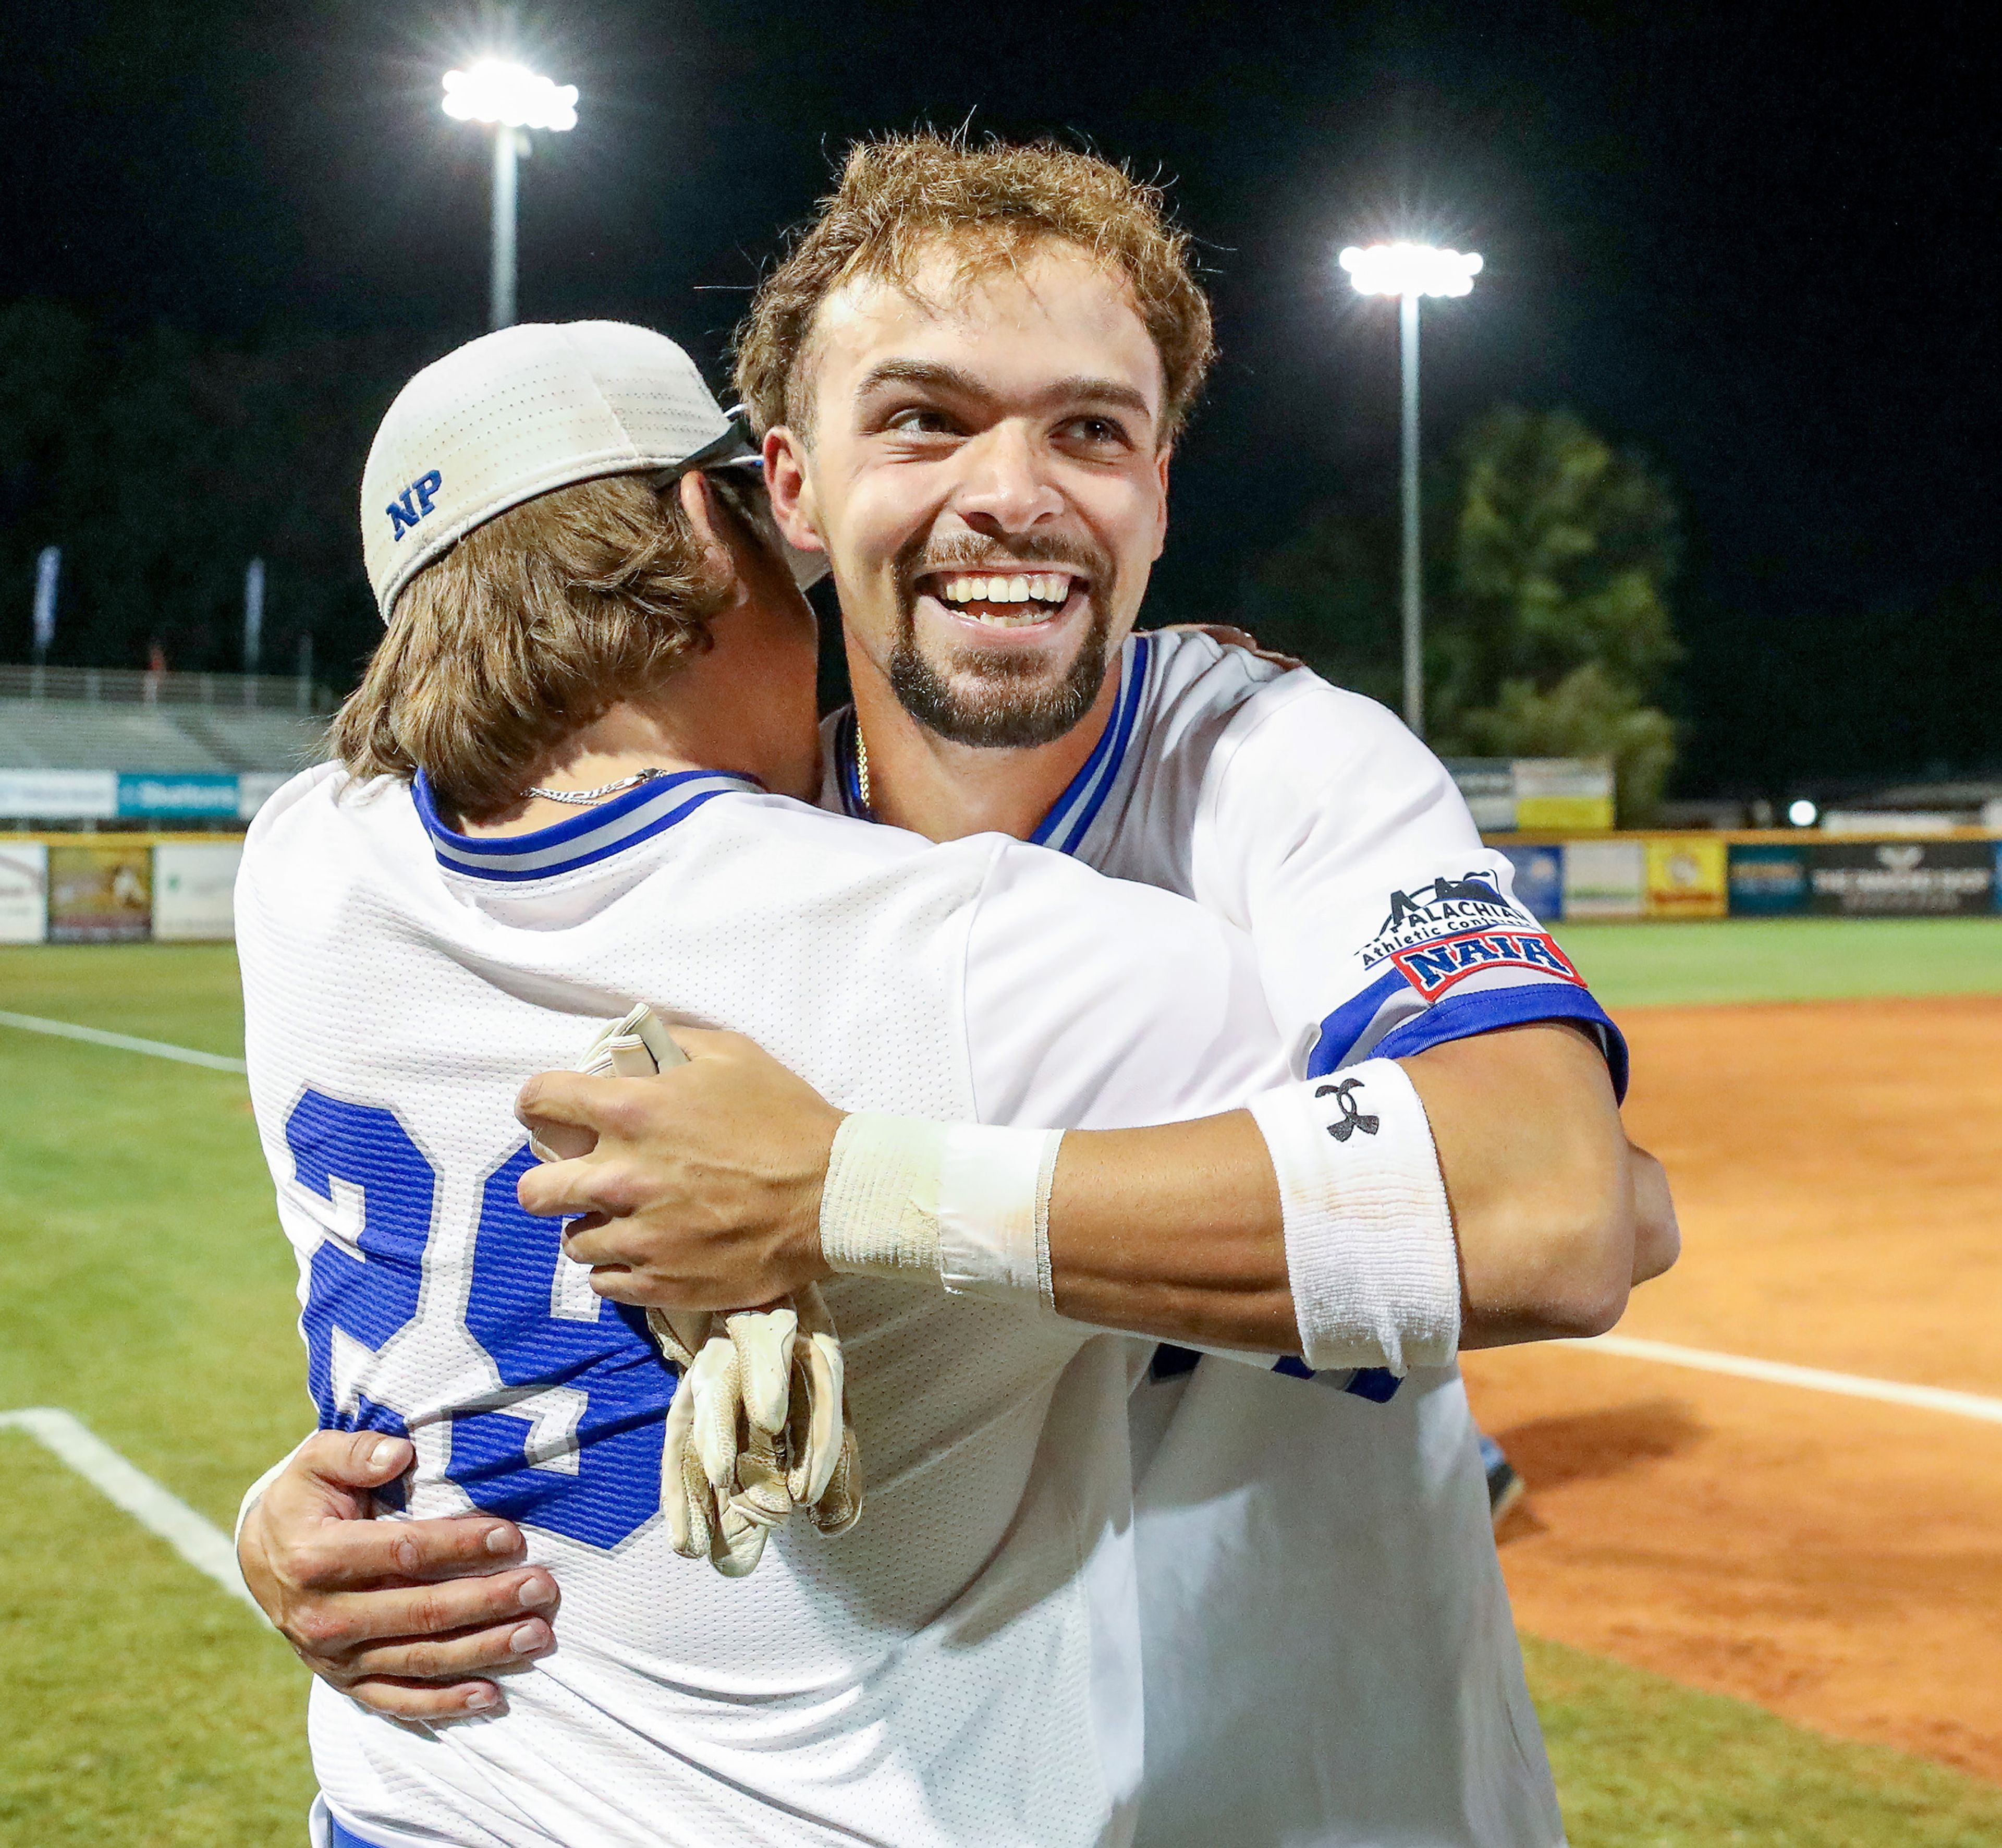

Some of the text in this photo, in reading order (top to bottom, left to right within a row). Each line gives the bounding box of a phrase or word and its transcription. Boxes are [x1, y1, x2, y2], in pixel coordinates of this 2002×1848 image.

[386, 470, 442, 541] NP
[1363, 927, 1441, 966] Athletic
[1403, 936, 1572, 989] NAIA
